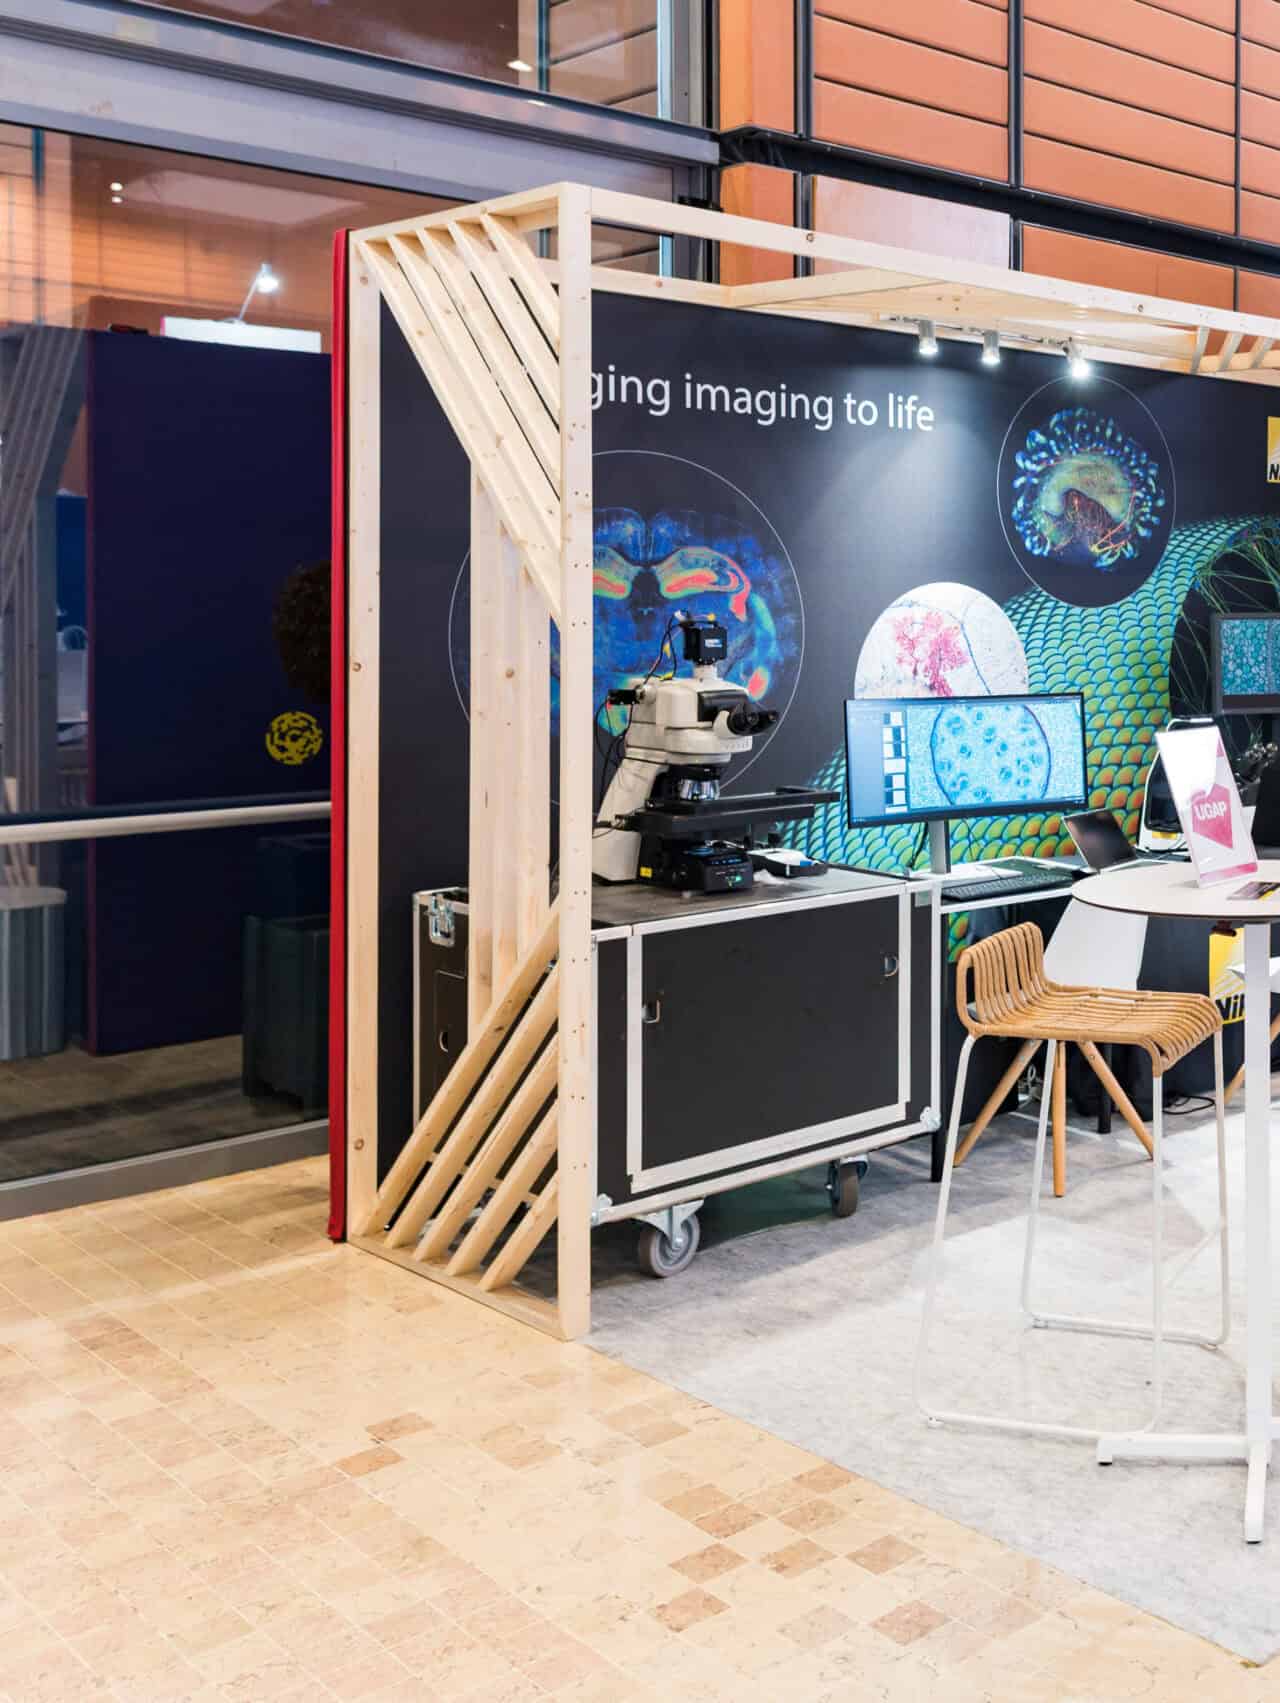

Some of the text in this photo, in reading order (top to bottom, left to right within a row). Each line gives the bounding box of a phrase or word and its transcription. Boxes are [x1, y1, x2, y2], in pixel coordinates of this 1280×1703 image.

[684, 372, 833, 431] imaging
[844, 392, 879, 426] to
[888, 392, 936, 432] life
[1194, 800, 1228, 821] UGAP
